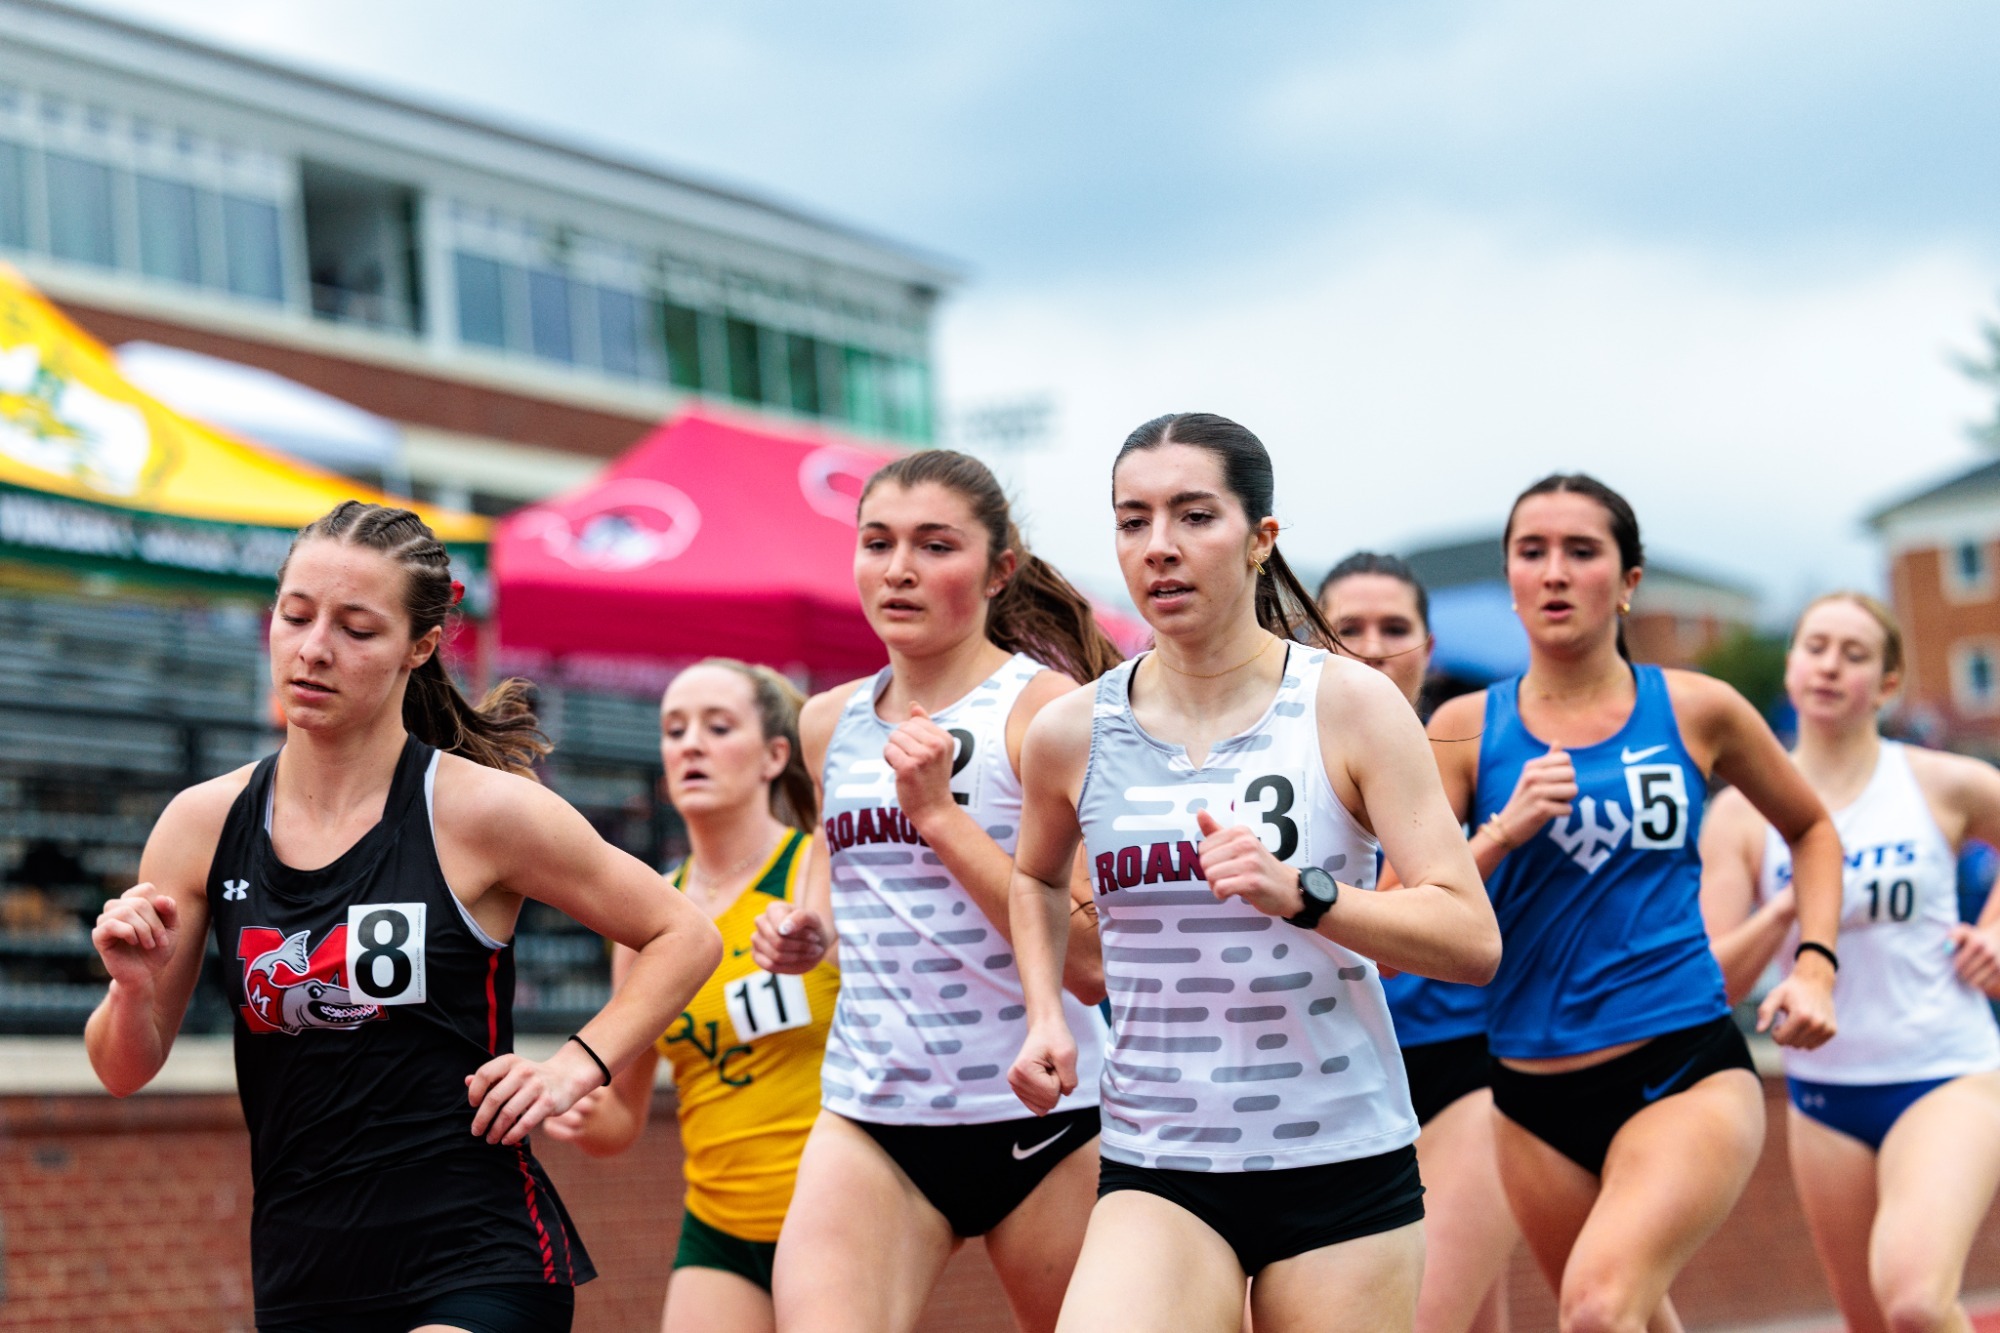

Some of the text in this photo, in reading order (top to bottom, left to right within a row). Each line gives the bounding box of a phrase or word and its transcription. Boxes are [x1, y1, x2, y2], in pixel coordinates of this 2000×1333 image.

[1244, 775, 1298, 862] 3
[1640, 773, 1678, 842] 5
[1865, 879, 1914, 922] 10
[355, 909, 412, 999] 8
[735, 973, 788, 1033] 11
